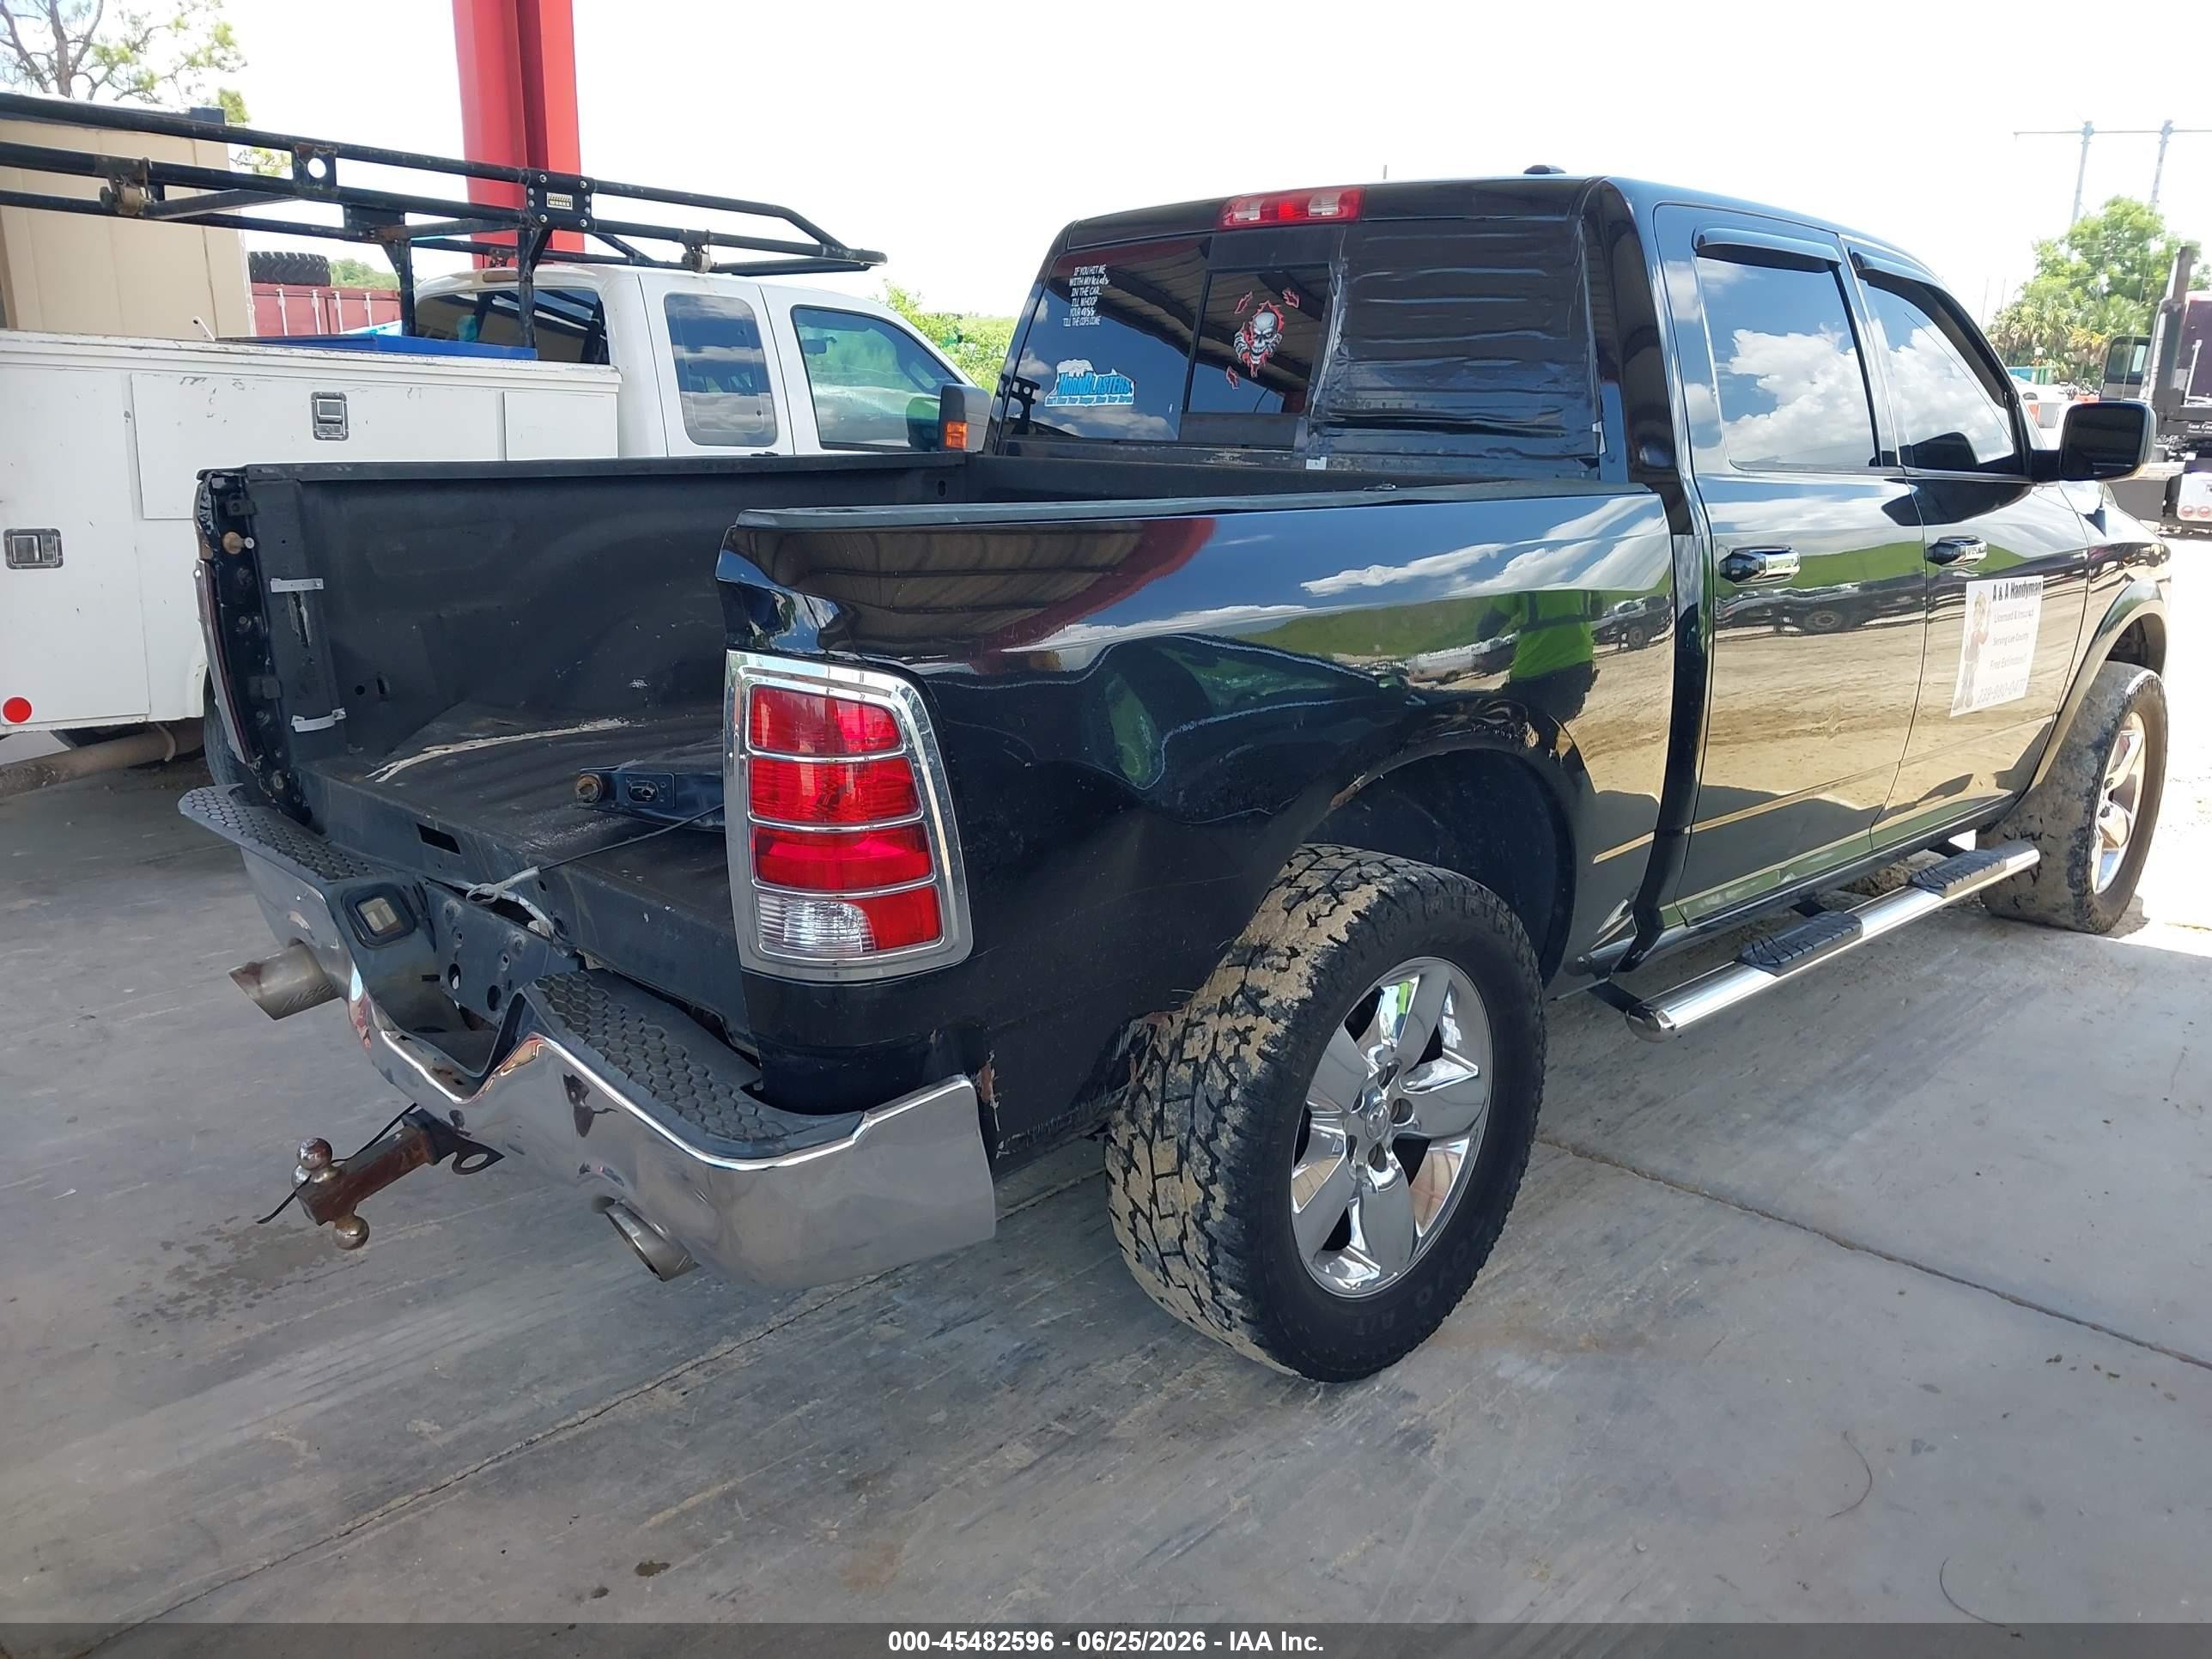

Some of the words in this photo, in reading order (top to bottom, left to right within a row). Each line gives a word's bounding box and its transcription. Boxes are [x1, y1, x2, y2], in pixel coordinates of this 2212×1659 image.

[1073, 266, 1080, 276] IF
[1080, 266, 1090, 276] YOU
[1089, 265, 1099, 275] HIT
[1098, 264, 1107, 274] ME
[1069, 277, 1084, 286] WITH
[1083, 276, 1092, 285] MY
[1091, 274, 1110, 285] kids
[1071, 288, 1079, 297] IN
[1079, 286, 1090, 296] THE
[1080, 296, 1098, 307] WHOOP
[1070, 307, 1081, 317] YOUR
[1081, 307, 1096, 317] ass
[1072, 317, 1080, 326] THE
[1079, 316, 1090, 325] COPS
[1089, 315, 1101, 325] COME
[1992, 584, 1997, 602] A
[1998, 586, 2003, 601] &
[2004, 583, 2009, 600] A
[2010, 580, 2042, 599] Handyman
